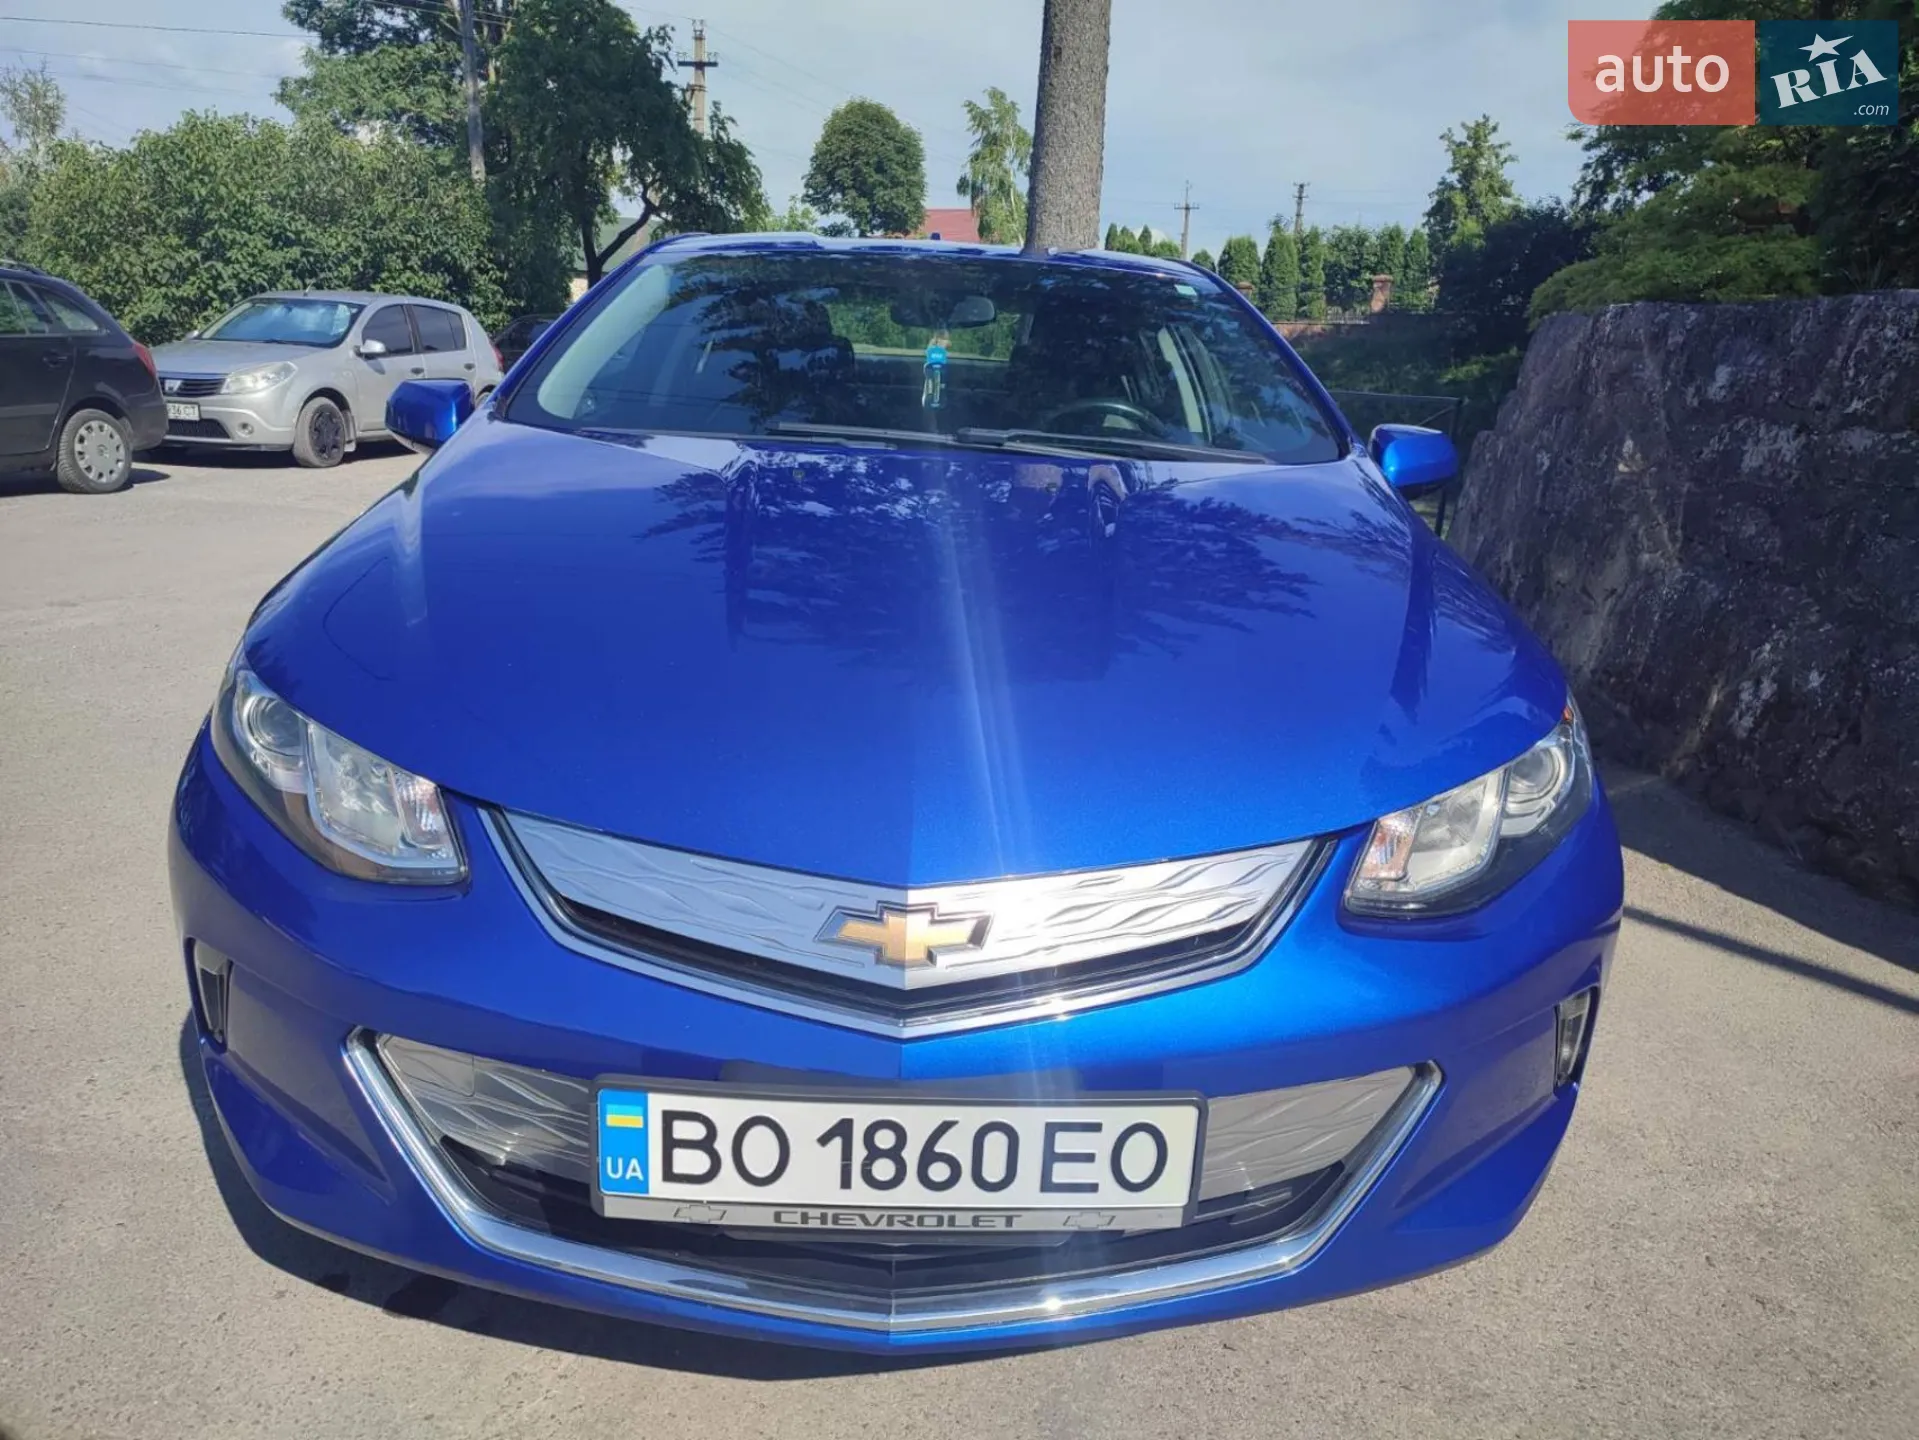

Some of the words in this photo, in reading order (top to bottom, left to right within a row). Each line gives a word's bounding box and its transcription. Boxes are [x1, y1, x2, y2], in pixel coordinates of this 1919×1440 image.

[662, 1109, 790, 1187] BO
[816, 1117, 1019, 1192] 1860
[1040, 1121, 1168, 1193] EO
[606, 1157, 643, 1180] UA
[773, 1210, 1022, 1229] CHEVROLET
